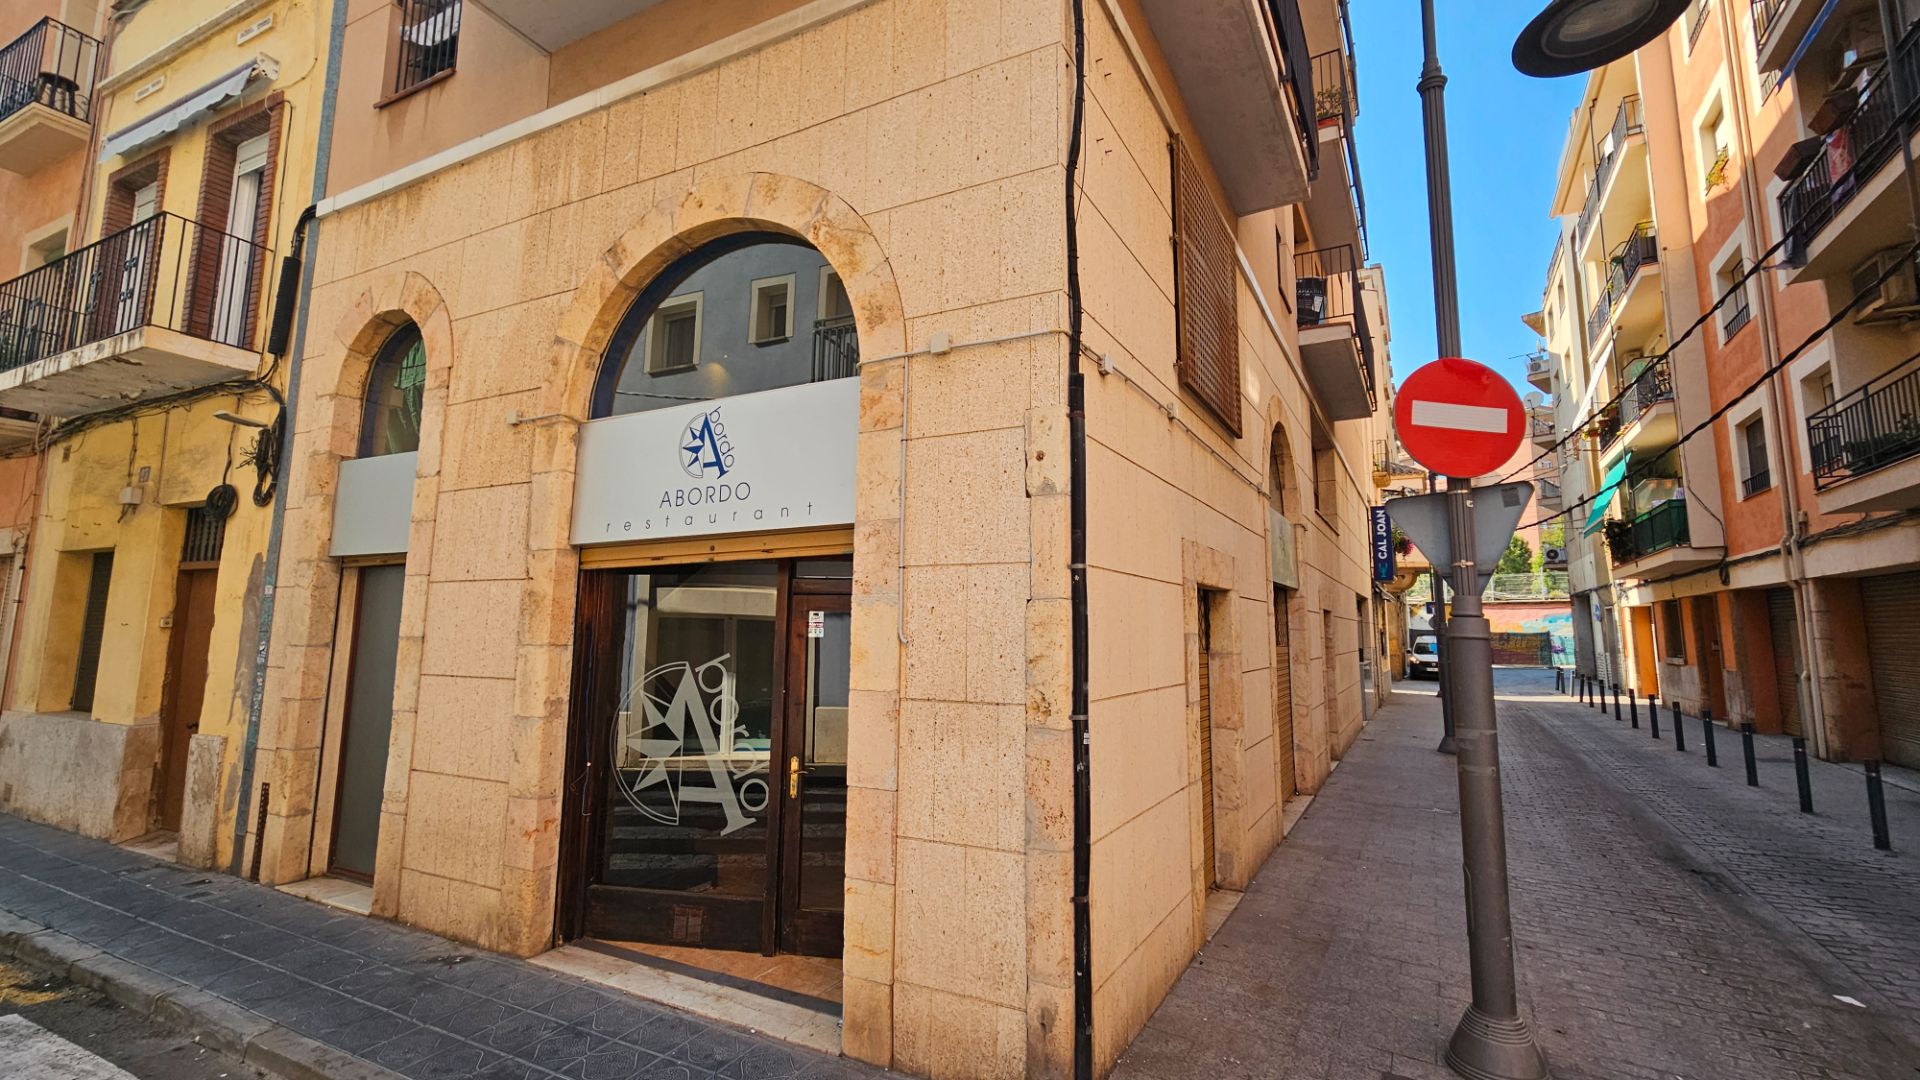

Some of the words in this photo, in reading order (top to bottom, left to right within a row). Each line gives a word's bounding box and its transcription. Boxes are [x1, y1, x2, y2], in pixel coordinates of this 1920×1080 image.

[659, 481, 752, 509] ABORDO
[605, 501, 815, 534] restaurant
[1375, 509, 1388, 537] JOAN
[1377, 539, 1389, 560] CAL
